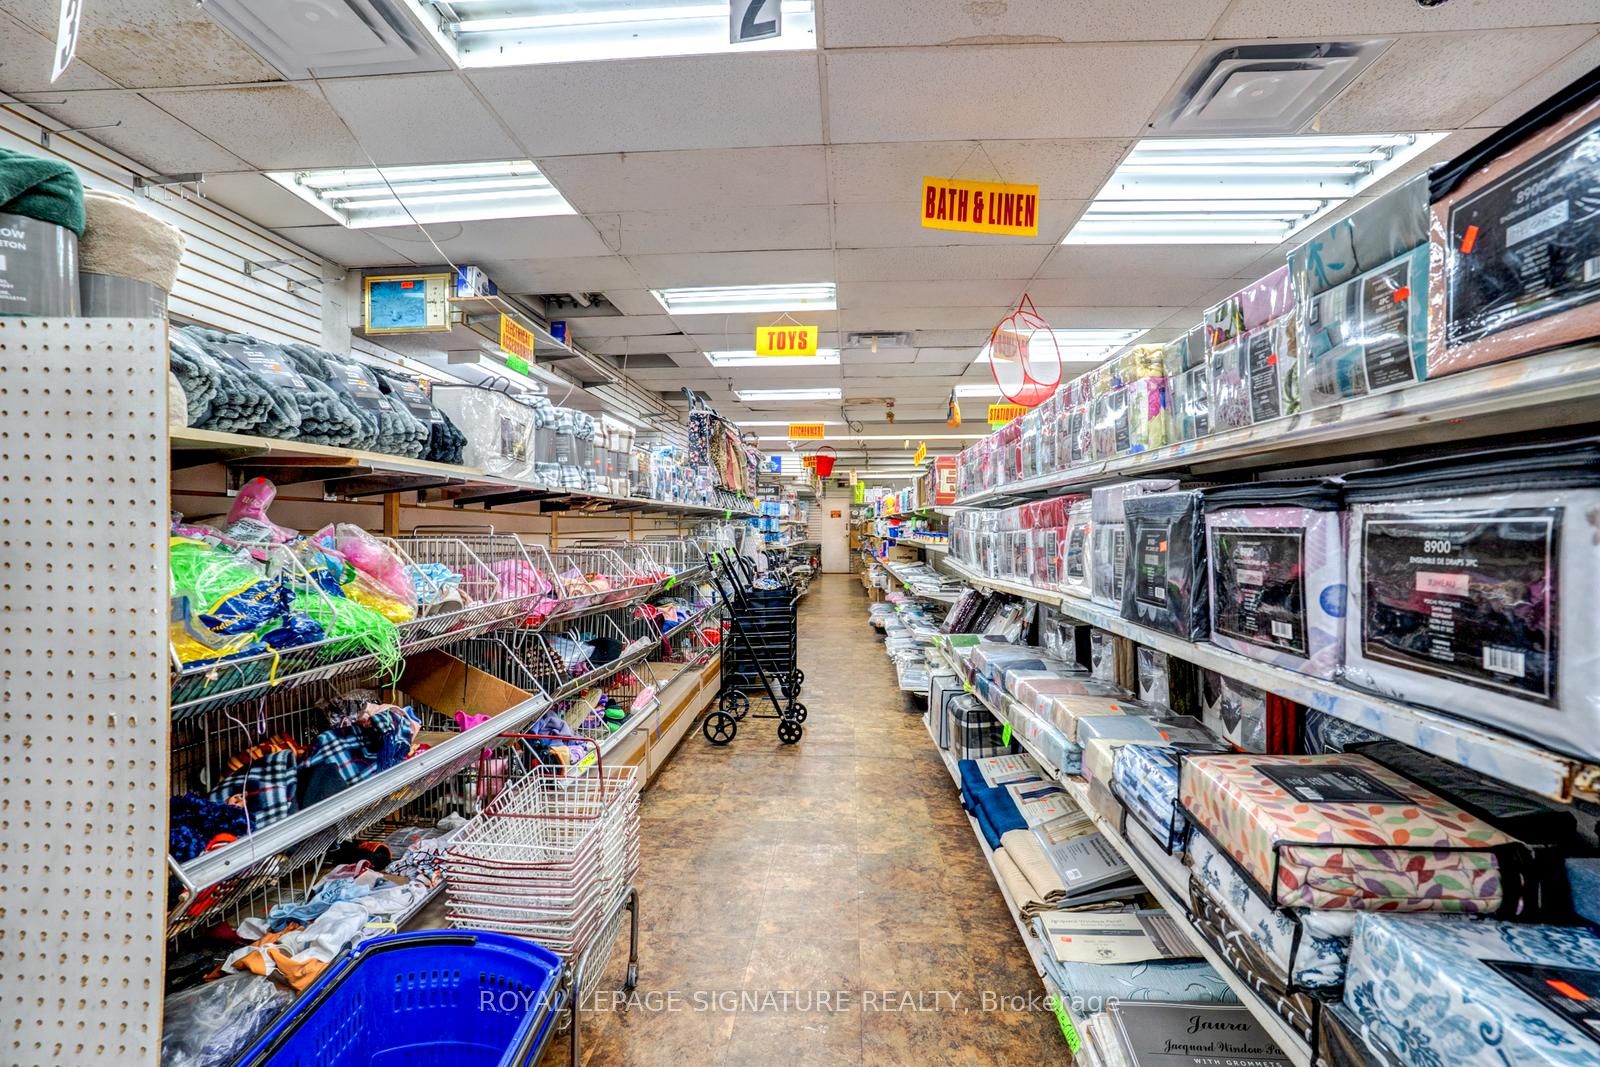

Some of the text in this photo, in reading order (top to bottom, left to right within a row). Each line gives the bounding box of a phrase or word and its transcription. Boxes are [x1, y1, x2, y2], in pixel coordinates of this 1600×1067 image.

[925, 186, 1036, 227] BATH & LINEN
[768, 331, 808, 350] TOYS
[1423, 540, 1451, 554] 8900
[1164, 1039, 1215, 1056] Jacquard
[1217, 1041, 1263, 1054] Window
[1193, 1058, 1221, 1066] WITH
